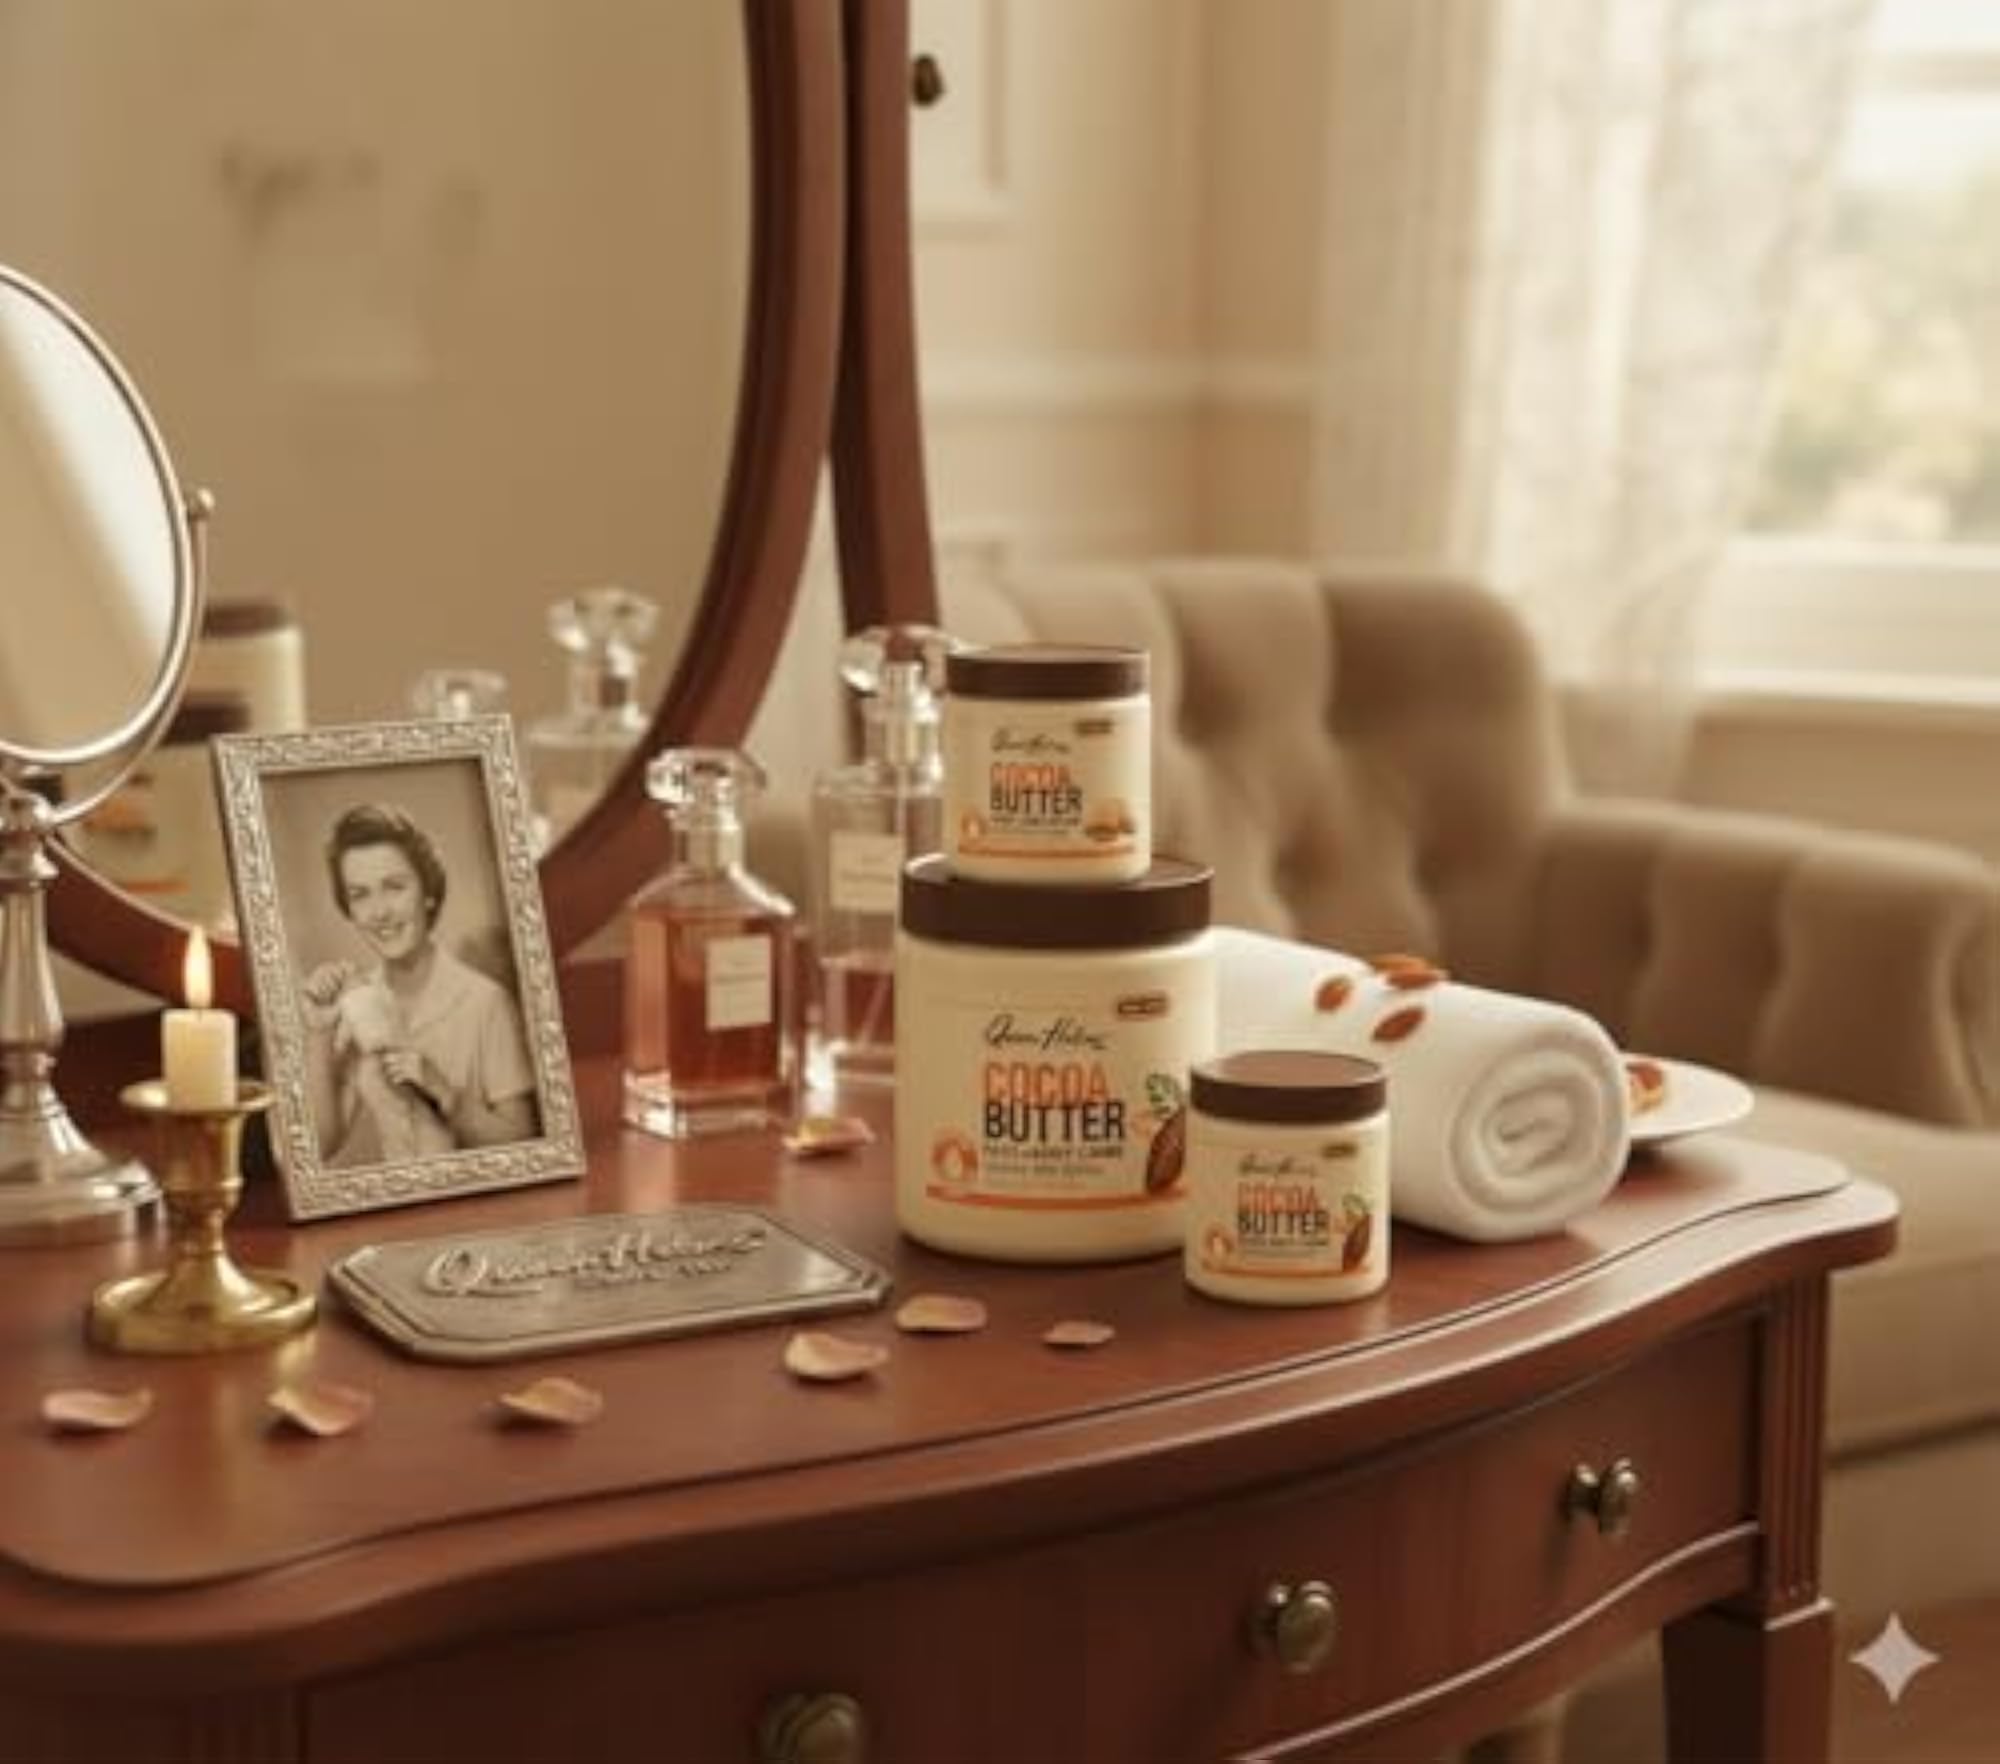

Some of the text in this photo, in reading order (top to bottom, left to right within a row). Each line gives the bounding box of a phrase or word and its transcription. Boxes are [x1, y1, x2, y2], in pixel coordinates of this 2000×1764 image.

[991, 785, 1082, 814] BUTTER
[985, 1061, 1109, 1104] COCOA
[985, 1100, 1125, 1142] BUTTER
